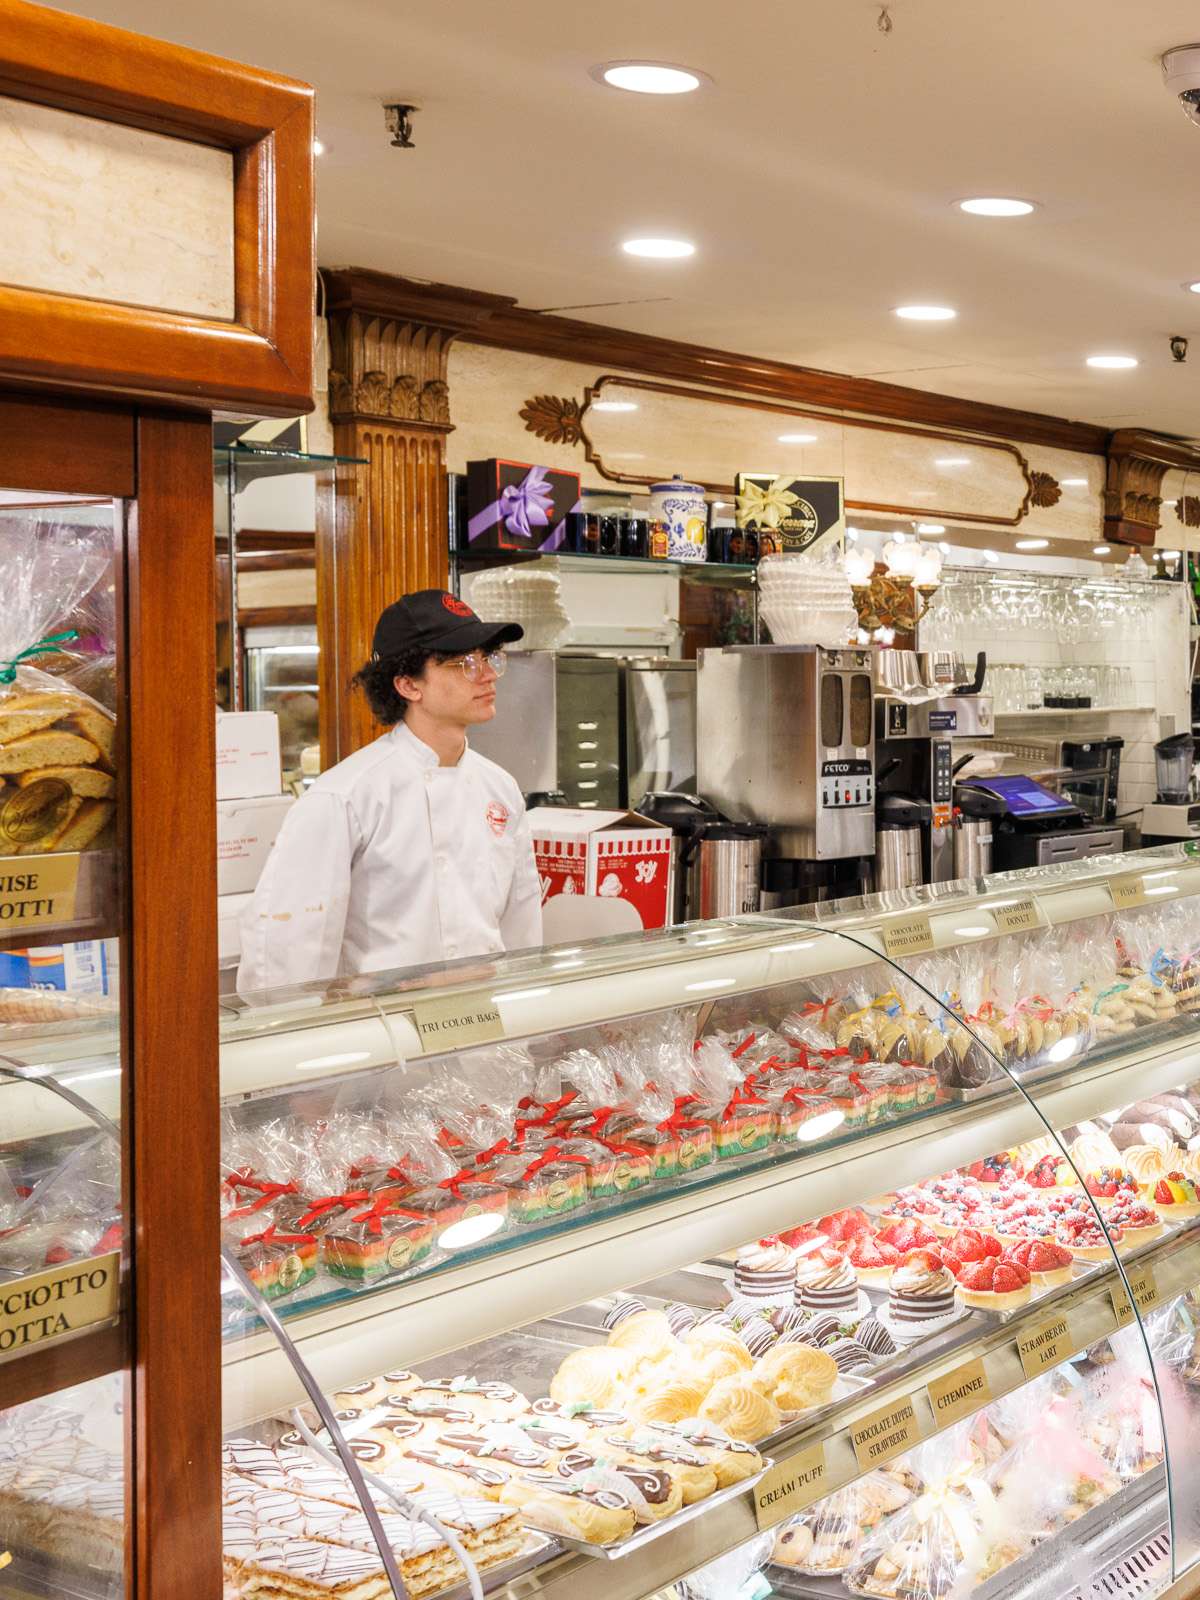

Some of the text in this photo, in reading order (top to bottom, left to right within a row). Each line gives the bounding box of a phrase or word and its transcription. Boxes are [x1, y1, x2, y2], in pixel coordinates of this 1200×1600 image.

[825, 764, 849, 773] FETCO
[420, 1012, 500, 1034] TRI COLOR BAGS
[0, 1269, 107, 1316] CIOTTO
[1140, 1289, 1156, 1305] TART
[1020, 1320, 1068, 1356] STRAWBERRY
[1039, 1345, 1057, 1364] TART
[937, 1376, 984, 1410] CHEMINEE
[854, 1406, 914, 1446] CHOCOLATE DIPPED
[869, 1427, 909, 1459] STRAWBERRY
[759, 1465, 825, 1509] CREAM PUFF
